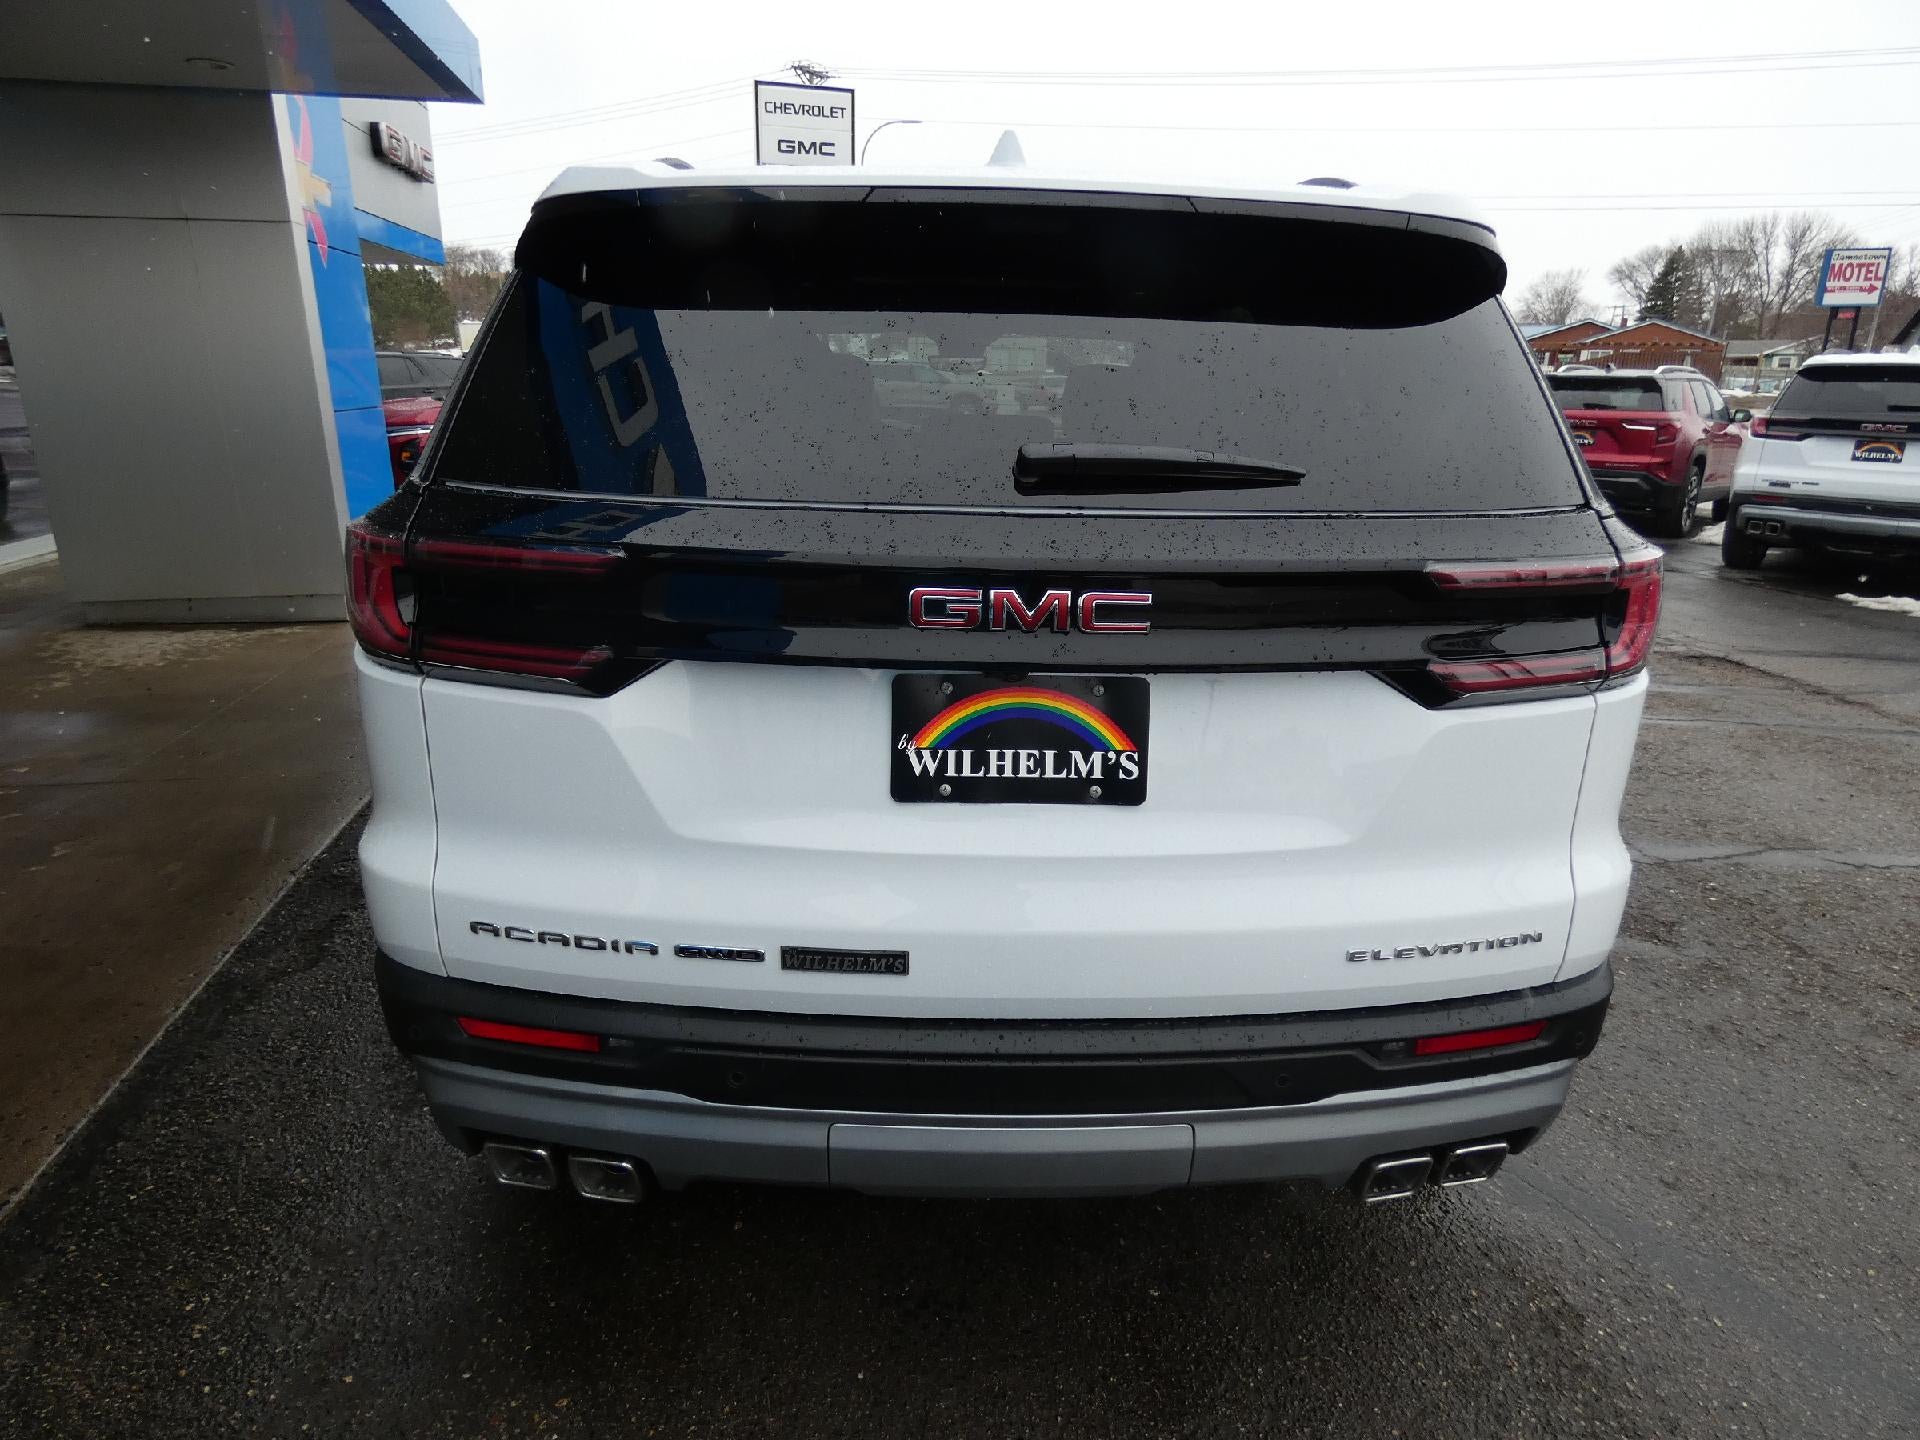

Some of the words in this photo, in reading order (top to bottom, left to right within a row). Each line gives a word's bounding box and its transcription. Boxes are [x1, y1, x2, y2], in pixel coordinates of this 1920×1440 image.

[764, 101, 847, 119] CHEVROLET
[370, 122, 434, 184] GMC
[777, 139, 836, 156] GMC
[1828, 262, 1883, 282] MOTEL
[908, 587, 1152, 633] GMC
[898, 733, 917, 754] by
[906, 749, 1140, 779] WILHELM'S
[469, 921, 659, 956] ACADIA
[1346, 929, 1543, 962] ELEVATION
[784, 954, 906, 973] WILHELM'S
